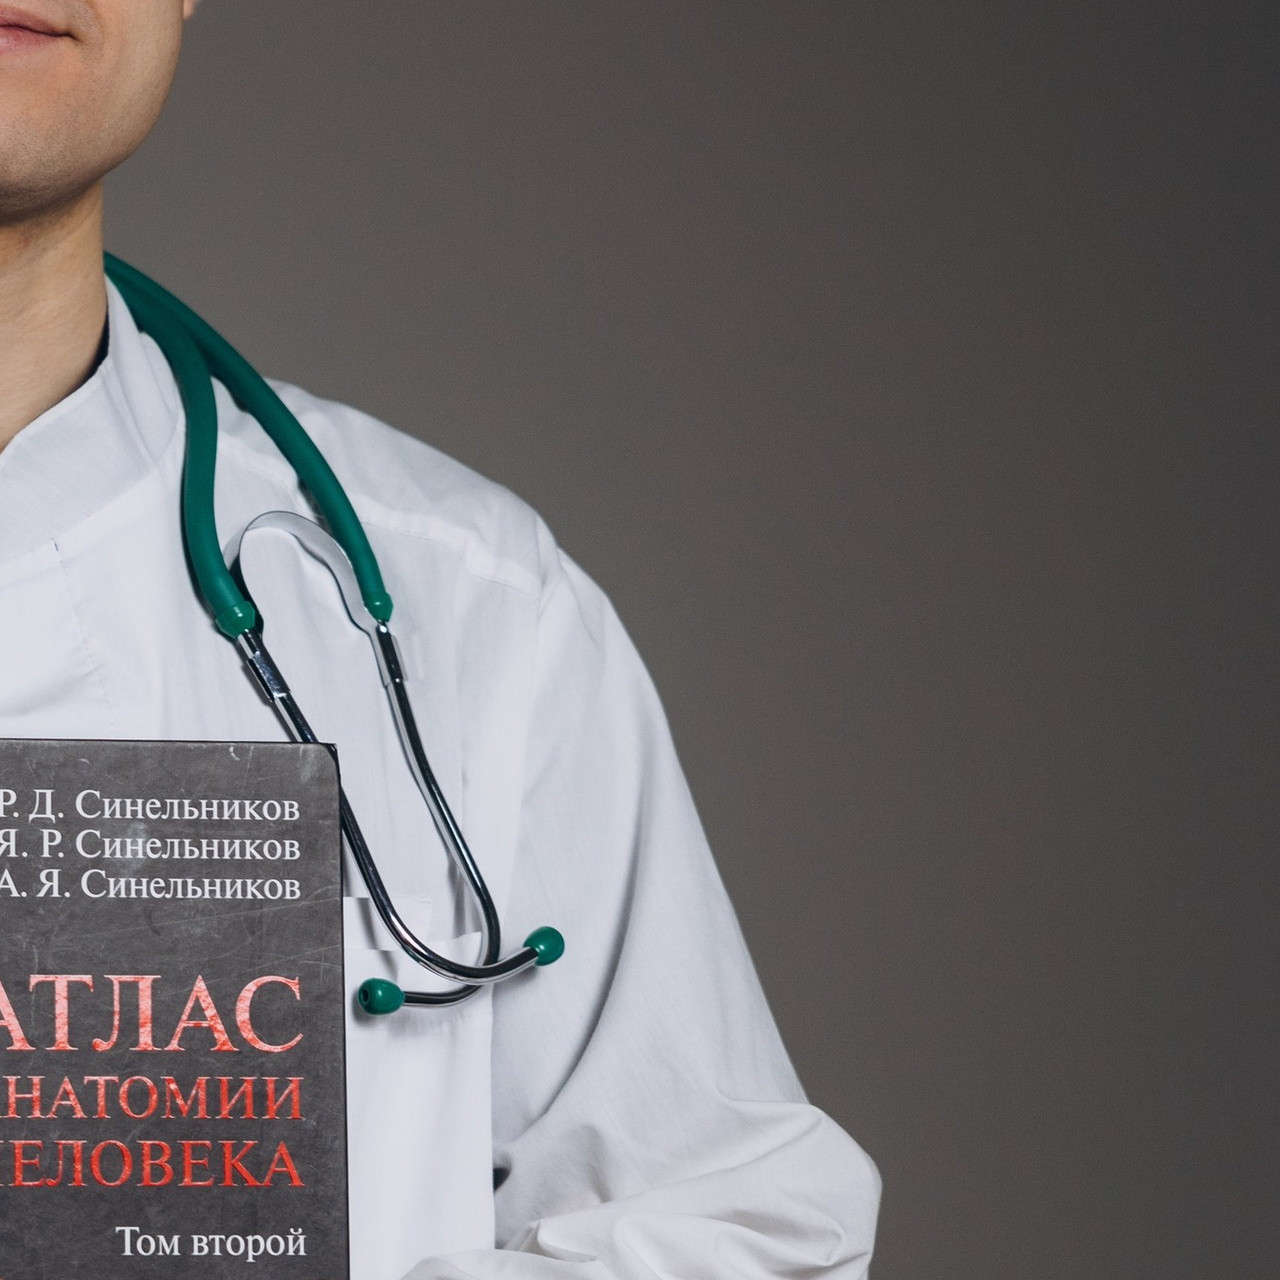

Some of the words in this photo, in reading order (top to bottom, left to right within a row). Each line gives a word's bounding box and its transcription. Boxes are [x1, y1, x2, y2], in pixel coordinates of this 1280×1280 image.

[28, 788, 65, 824] Д.
[75, 789, 301, 821] Синельников
[39, 828, 65, 858] Р.
[75, 829, 301, 860] Синельников
[35, 868, 71, 898] Я.
[80, 869, 302, 900] Синельников
[115, 1226, 181, 1256] Том
[191, 1227, 307, 1263] второй
